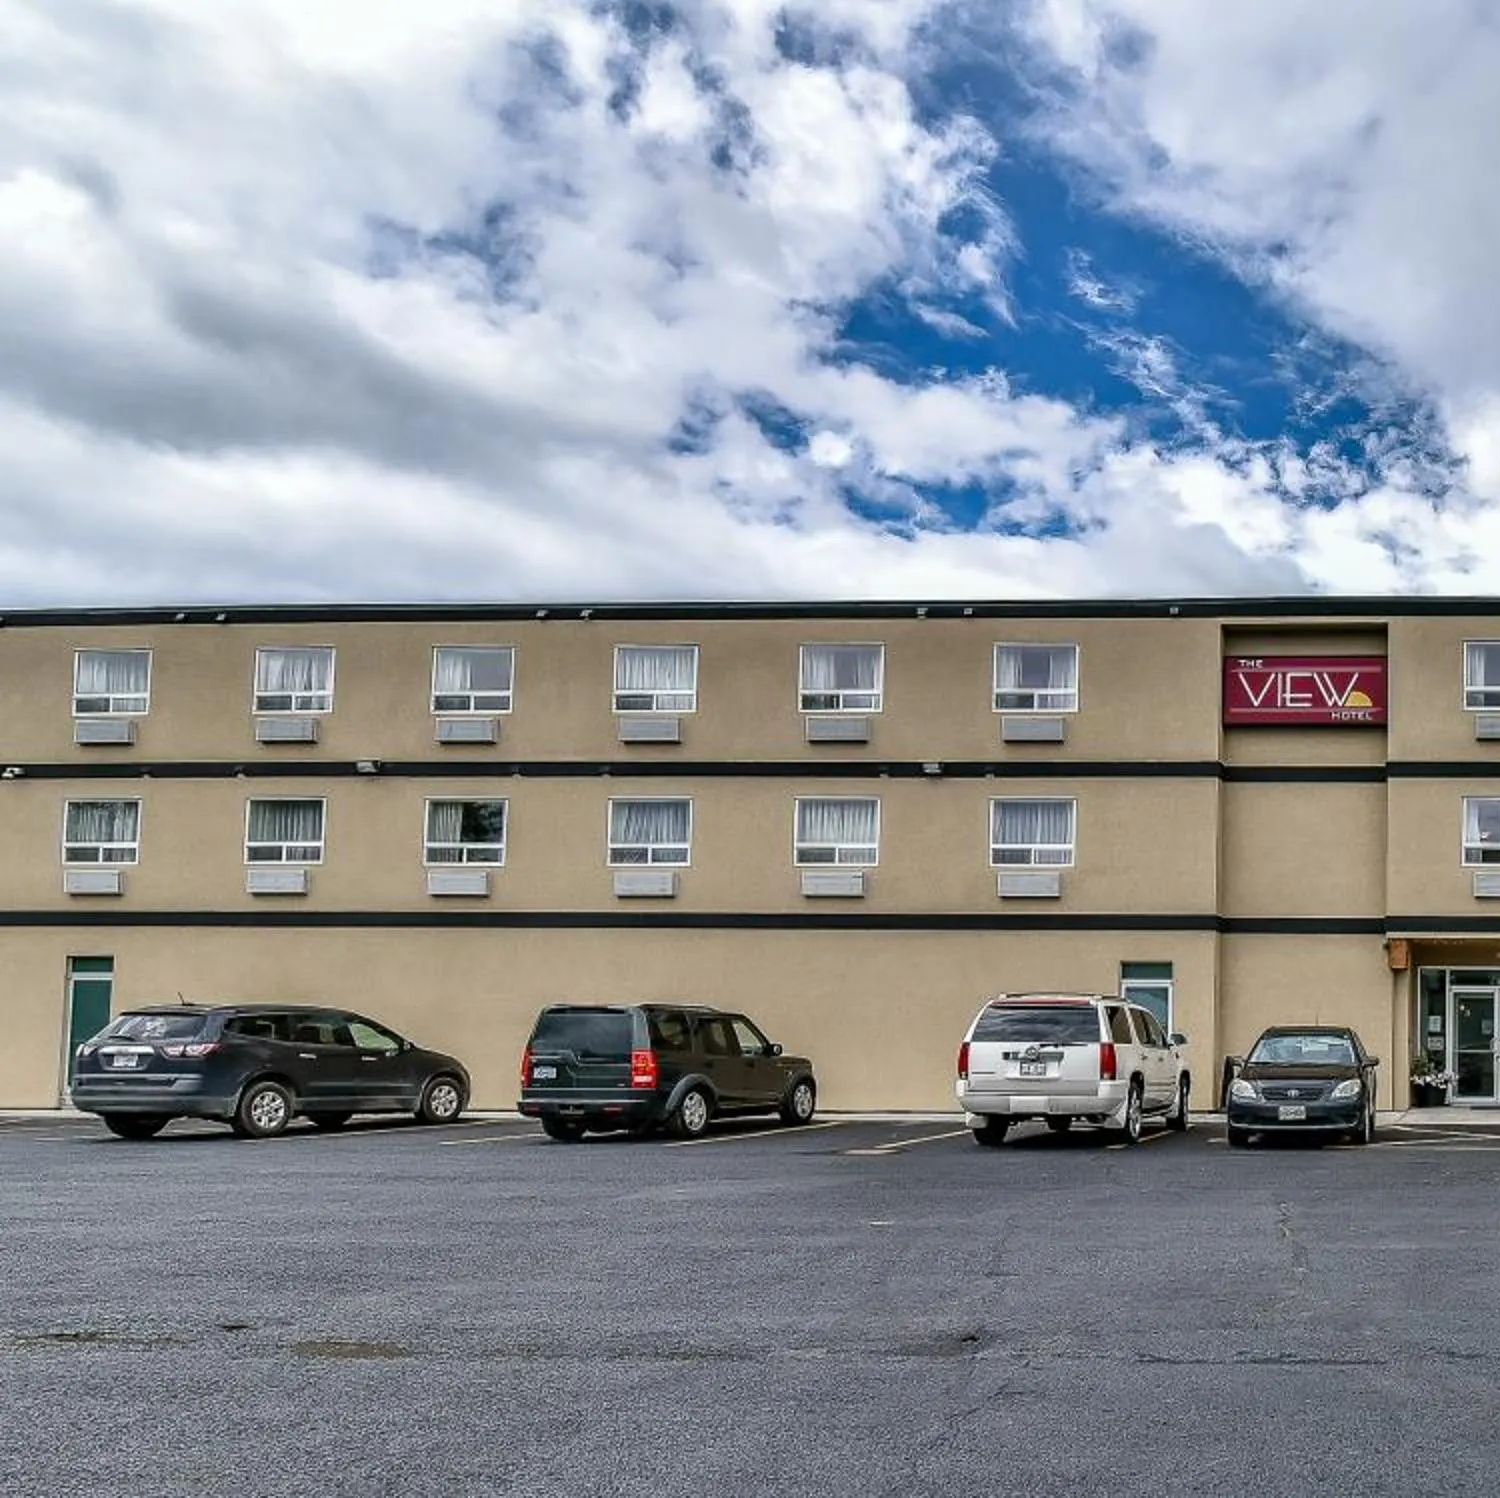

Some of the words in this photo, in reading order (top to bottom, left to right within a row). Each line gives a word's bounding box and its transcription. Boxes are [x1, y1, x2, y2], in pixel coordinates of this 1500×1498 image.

[1238, 659, 1264, 669] THE
[1238, 672, 1360, 707] VIEW
[1331, 712, 1373, 721] HOTEL
